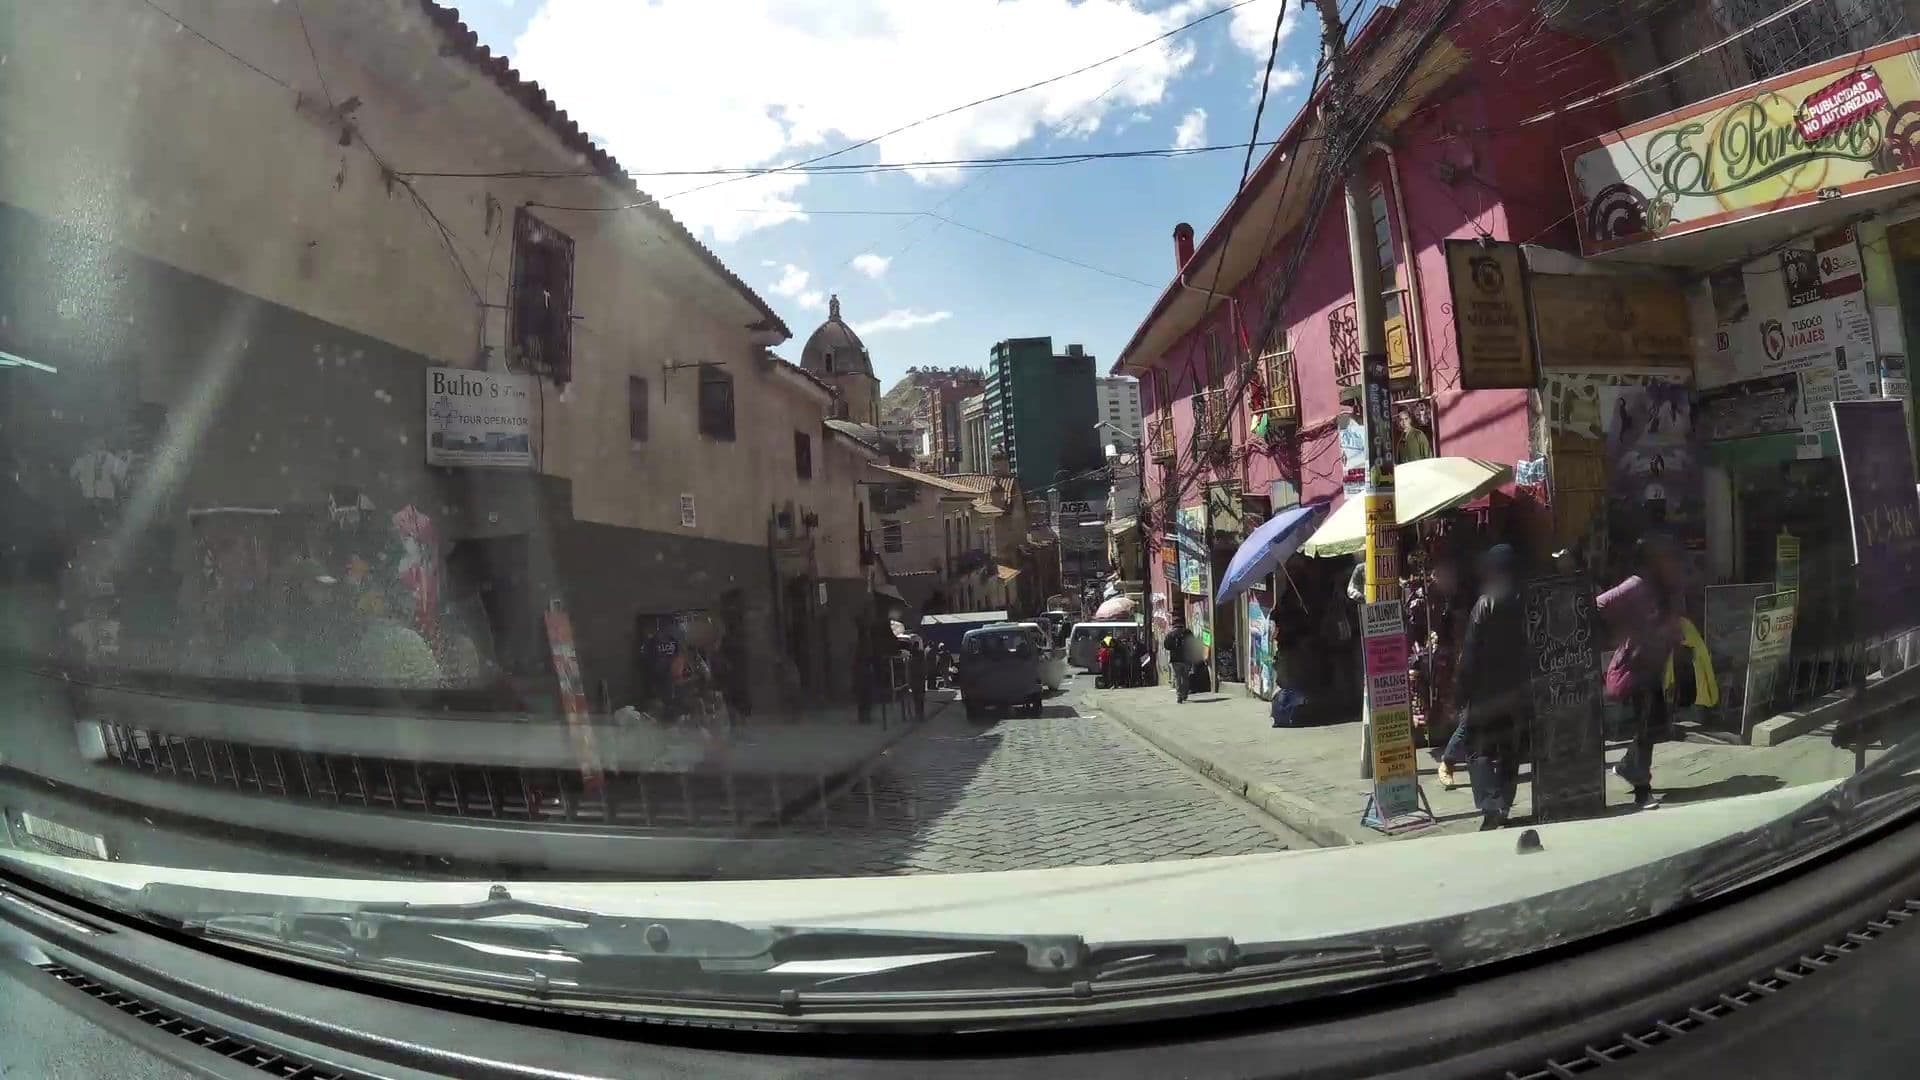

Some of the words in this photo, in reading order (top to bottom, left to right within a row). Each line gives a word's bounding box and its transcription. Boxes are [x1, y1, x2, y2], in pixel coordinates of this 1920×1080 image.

[1808, 80, 1868, 118] PUBLICIDAD
[1803, 118, 1821, 135] NO
[1821, 88, 1884, 126] AUTORIZADA
[1791, 315, 1823, 335] TUSOCO
[1786, 328, 1826, 349] VIAJES
[459, 415, 482, 425] TOUR
[484, 416, 529, 426] OPERATOR
[1060, 502, 1092, 514] AGFA
